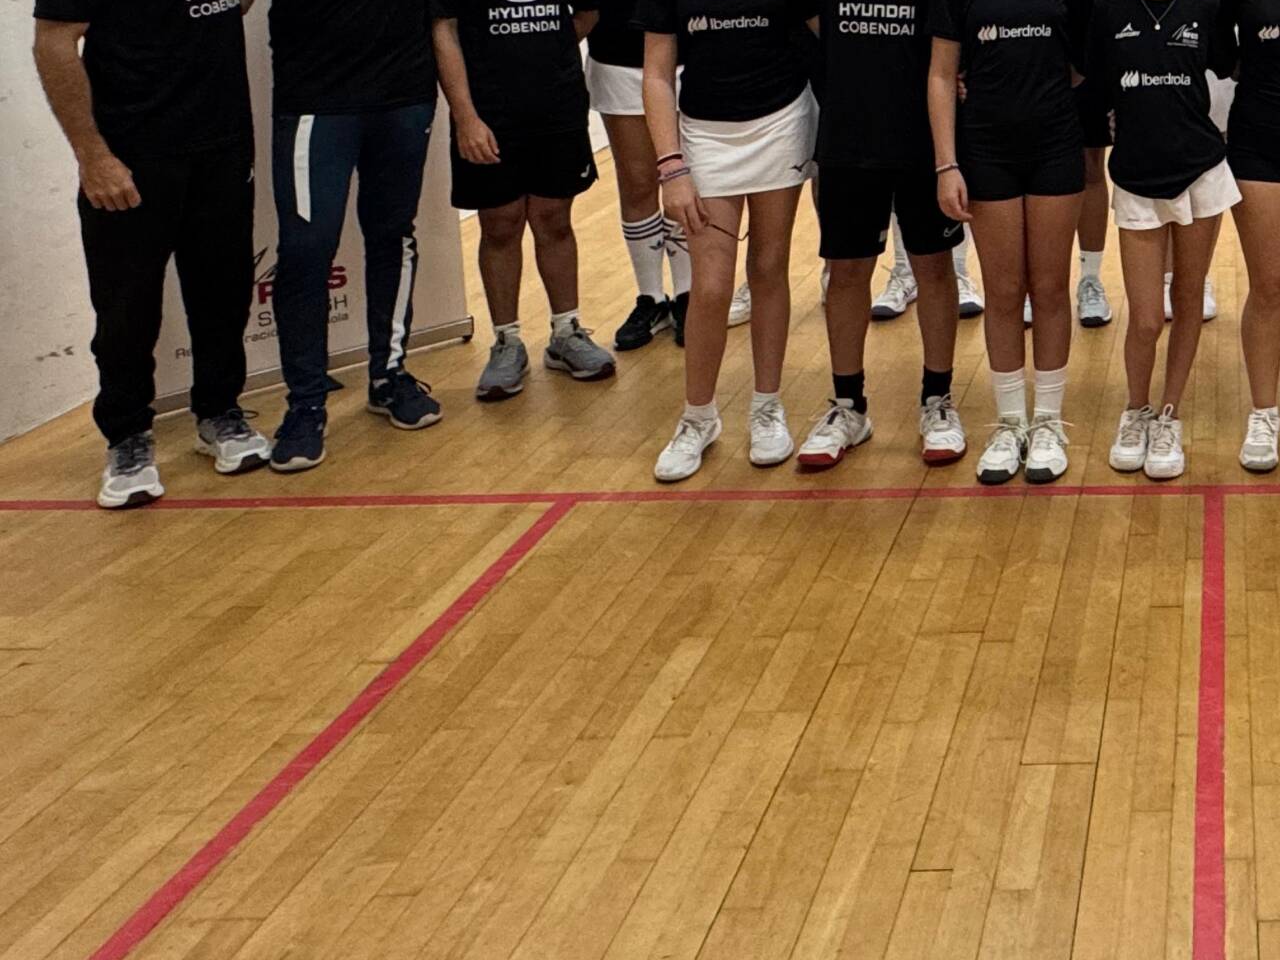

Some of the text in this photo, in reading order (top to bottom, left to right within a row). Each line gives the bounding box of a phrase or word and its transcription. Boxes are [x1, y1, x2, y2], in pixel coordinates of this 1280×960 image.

[488, 4, 559, 20] HYUNDAI
[839, 3, 915, 19] HYUNDAI
[489, 20, 560, 35] COBENDAI
[710, 16, 769, 31] Iberdrola
[839, 20, 915, 35] COBENDAI
[999, 24, 1052, 38] Iberdrola
[1141, 73, 1191, 86] Iberdrola
